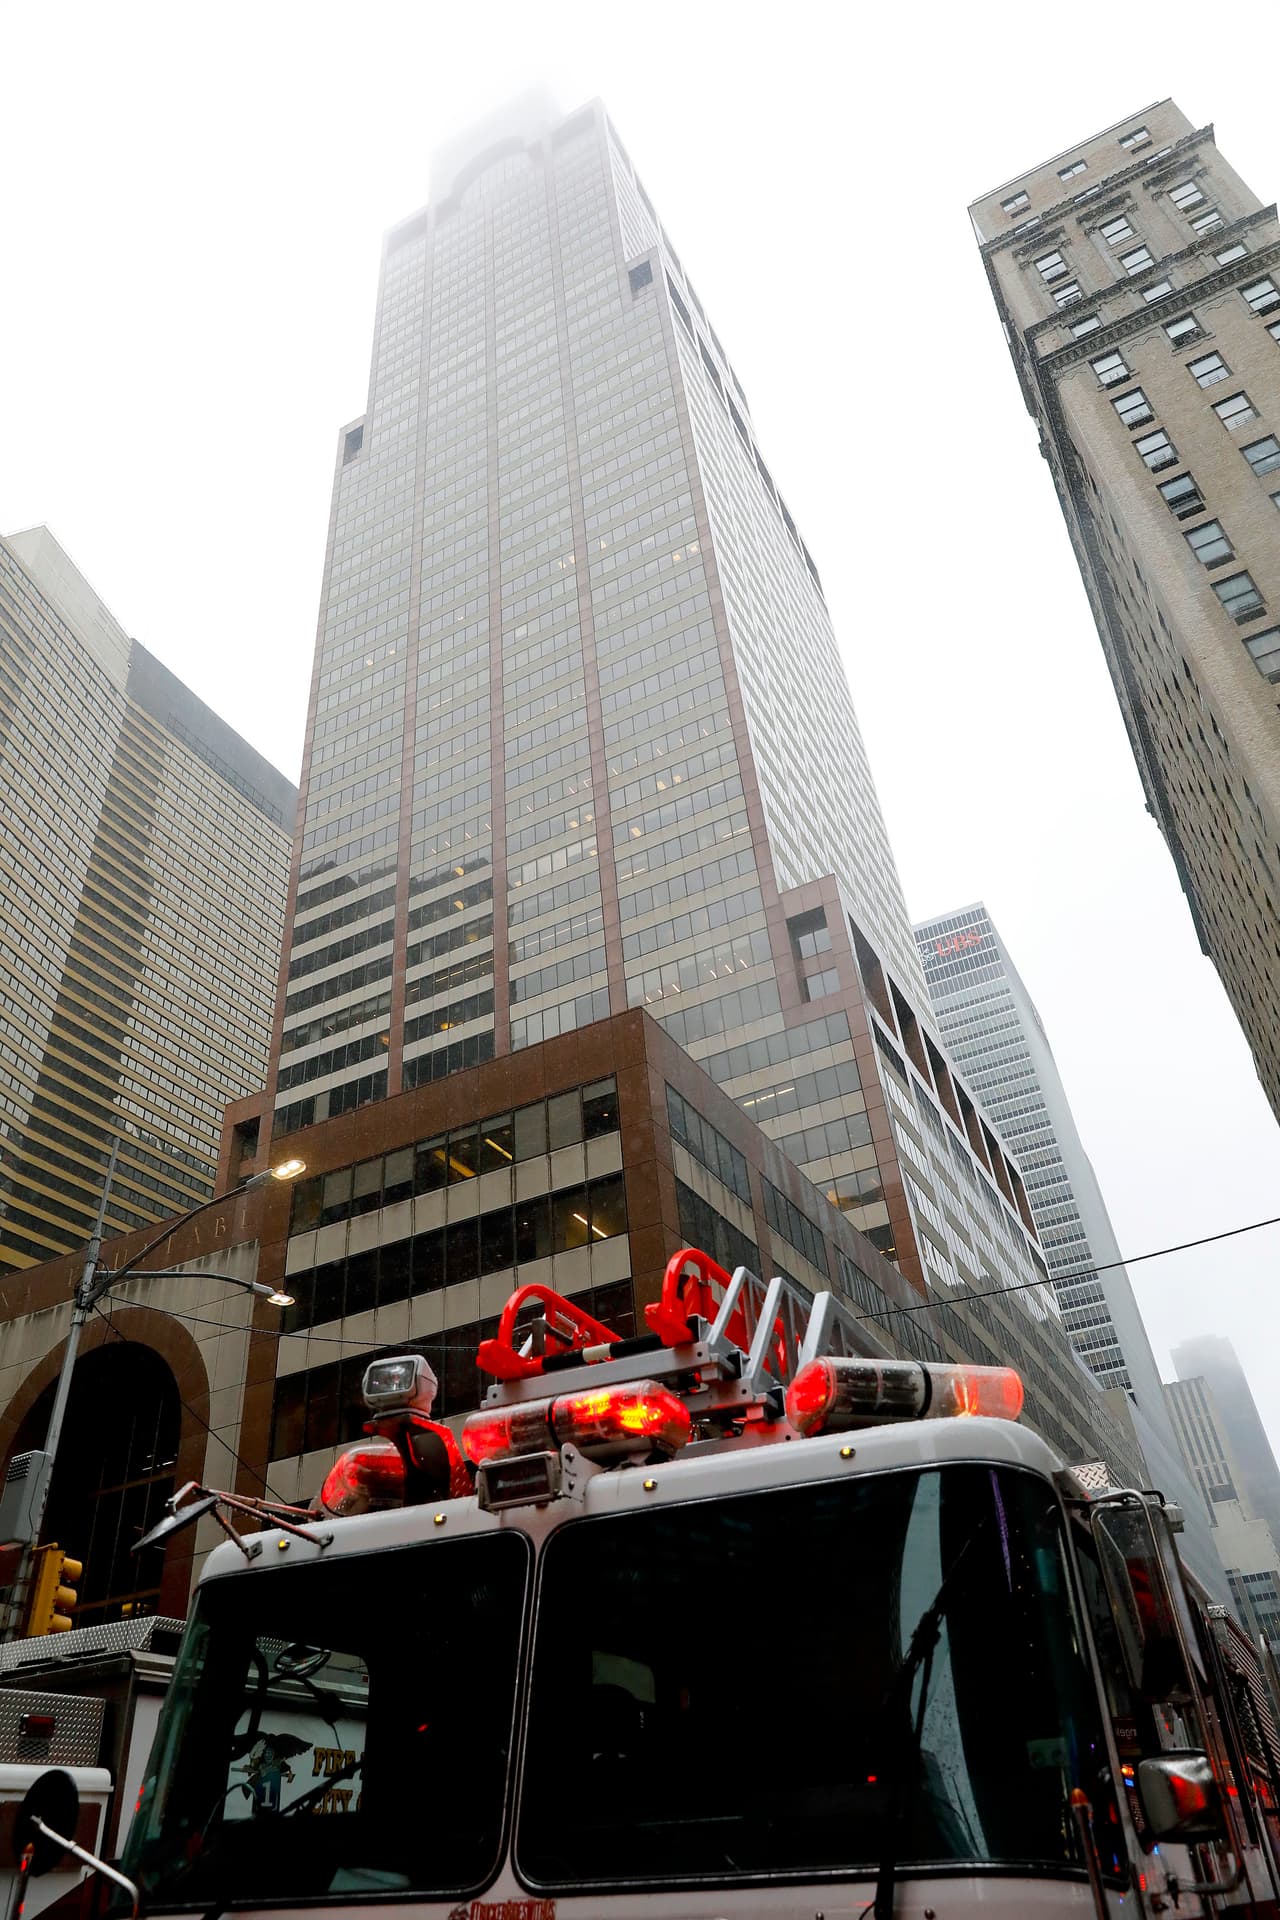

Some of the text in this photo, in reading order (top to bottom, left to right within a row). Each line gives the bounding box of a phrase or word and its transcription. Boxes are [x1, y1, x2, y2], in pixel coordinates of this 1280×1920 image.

[936, 928, 983, 957] UBS
[312, 1747, 355, 1777] FIRE
[261, 1780, 273, 1807] 1
